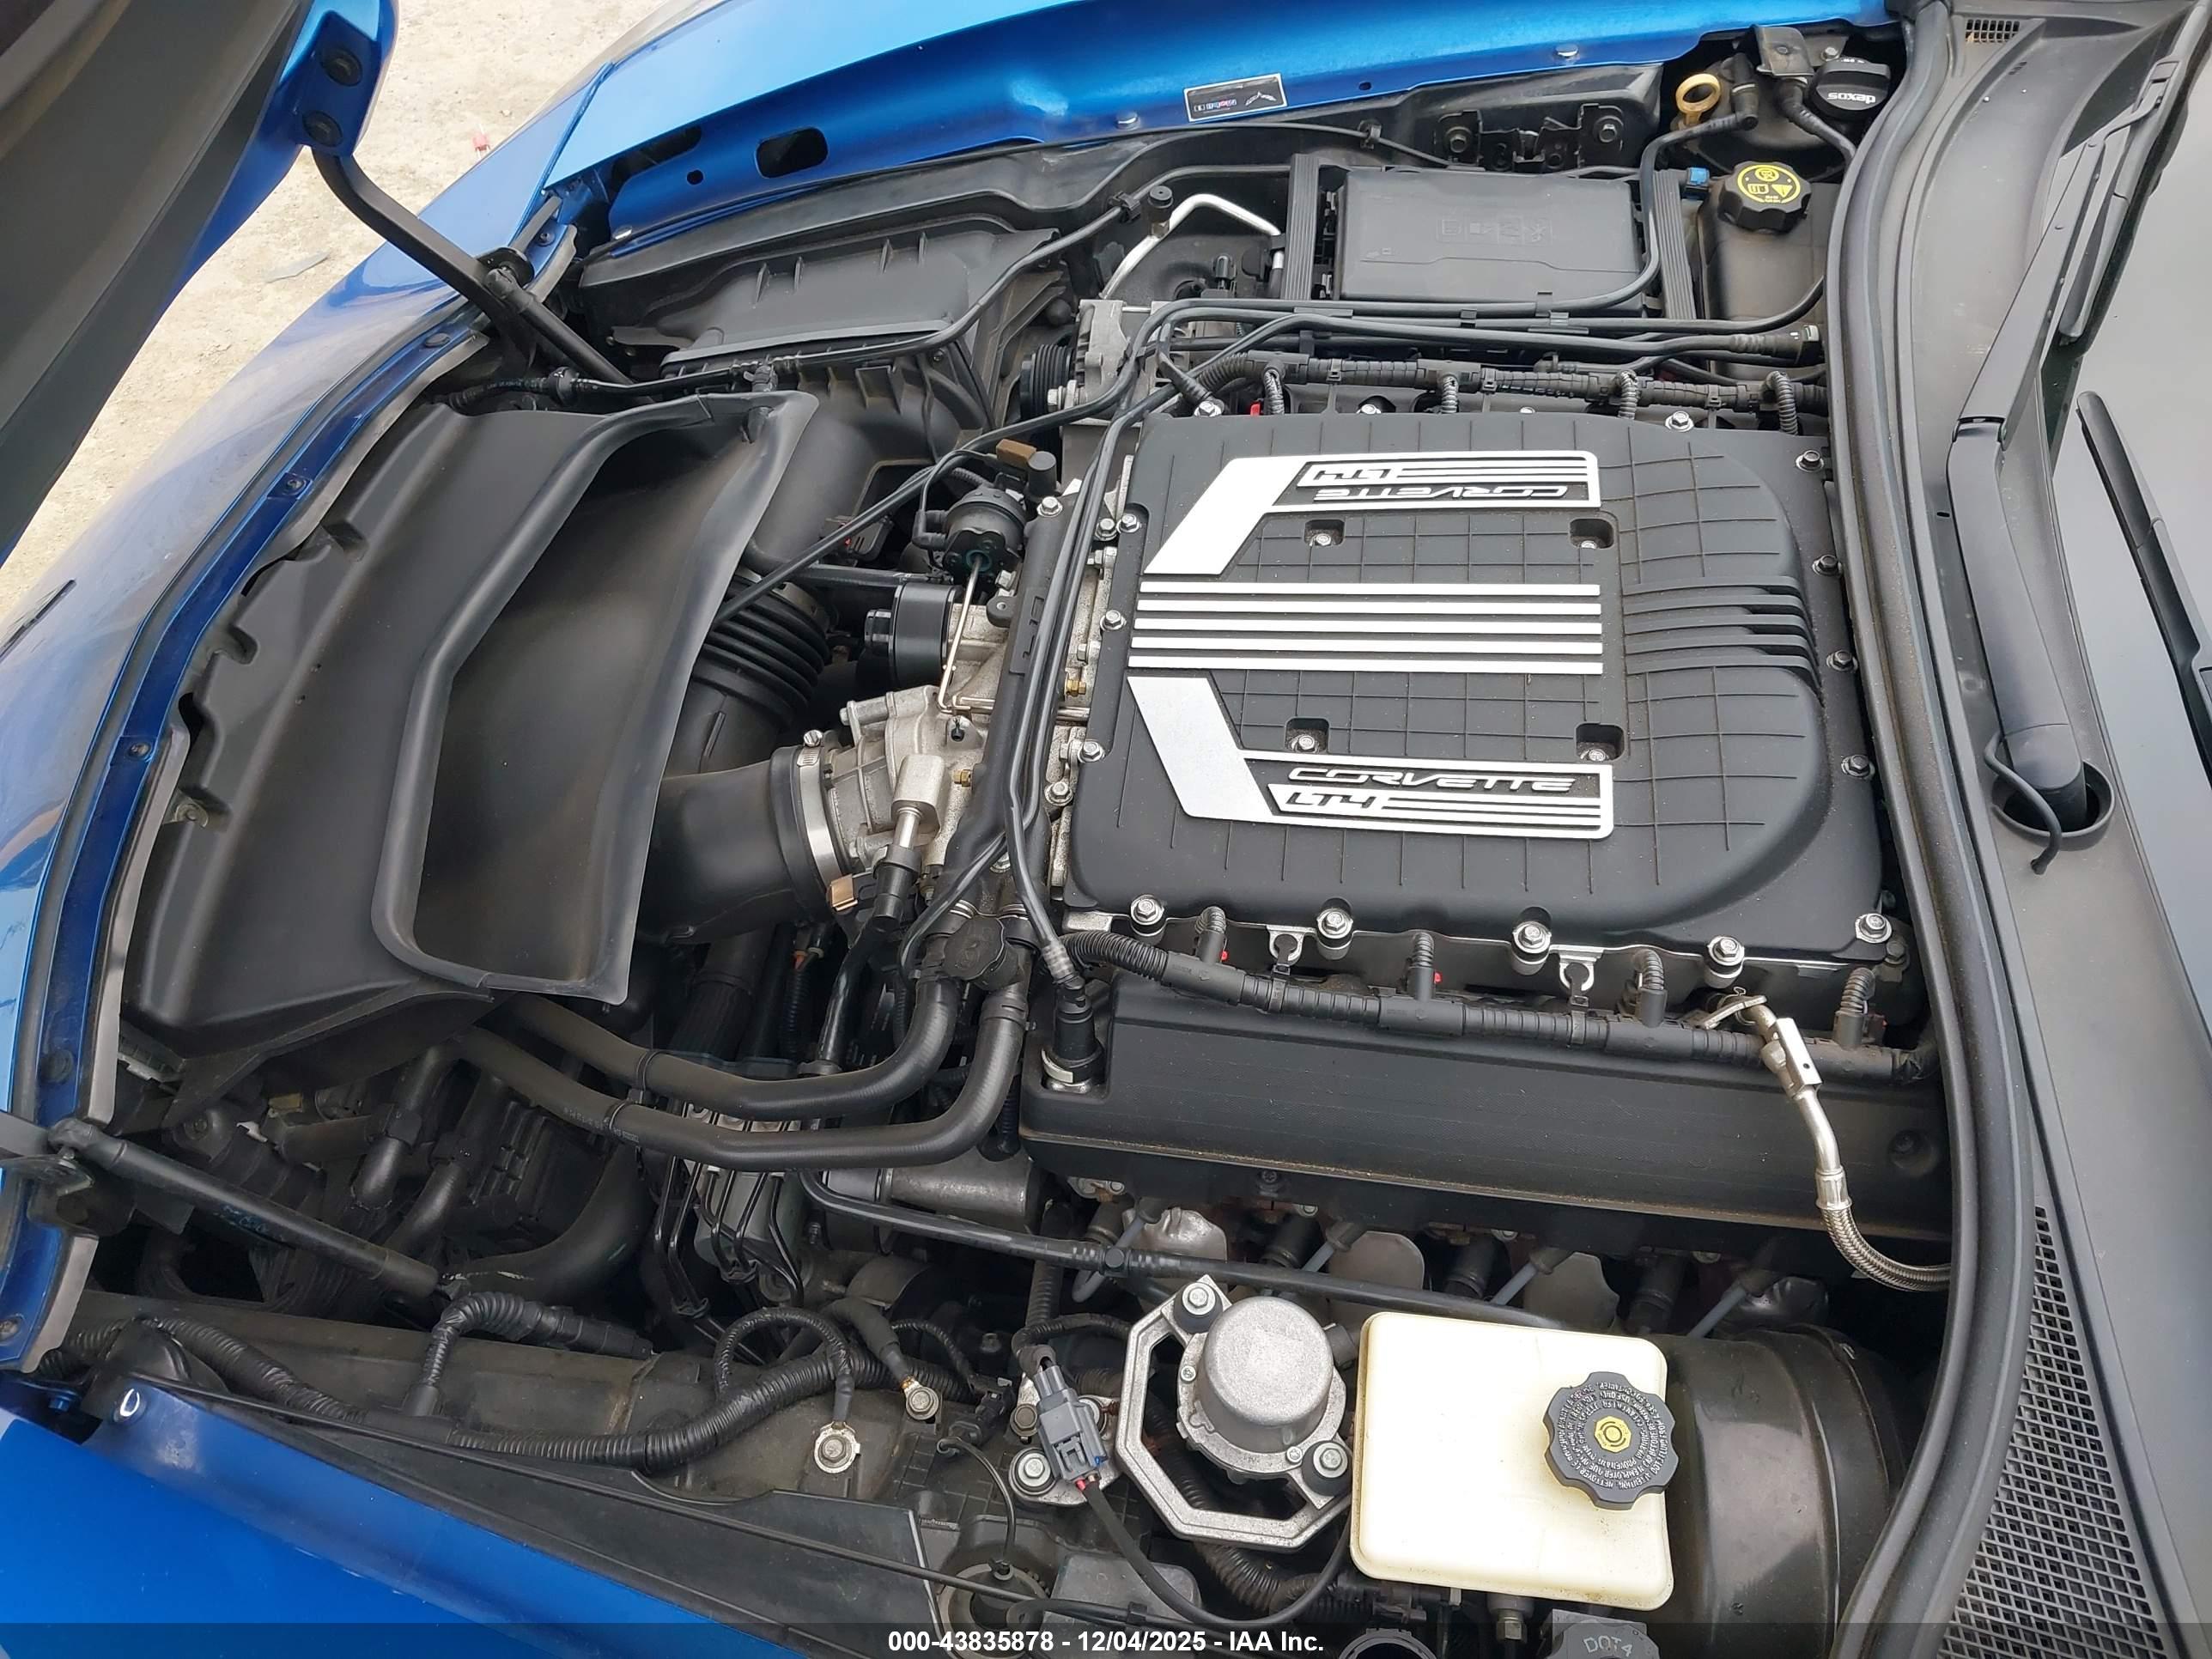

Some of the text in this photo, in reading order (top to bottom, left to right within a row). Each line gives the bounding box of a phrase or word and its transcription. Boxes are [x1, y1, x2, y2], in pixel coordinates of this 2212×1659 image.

[1826, 92, 1876, 104] dexos
[1313, 468, 1399, 481] LT4
[1312, 485, 1569, 502] CORVETTE
[1288, 766, 1577, 793] CORVETTE
[1285, 791, 1378, 810] LT4
